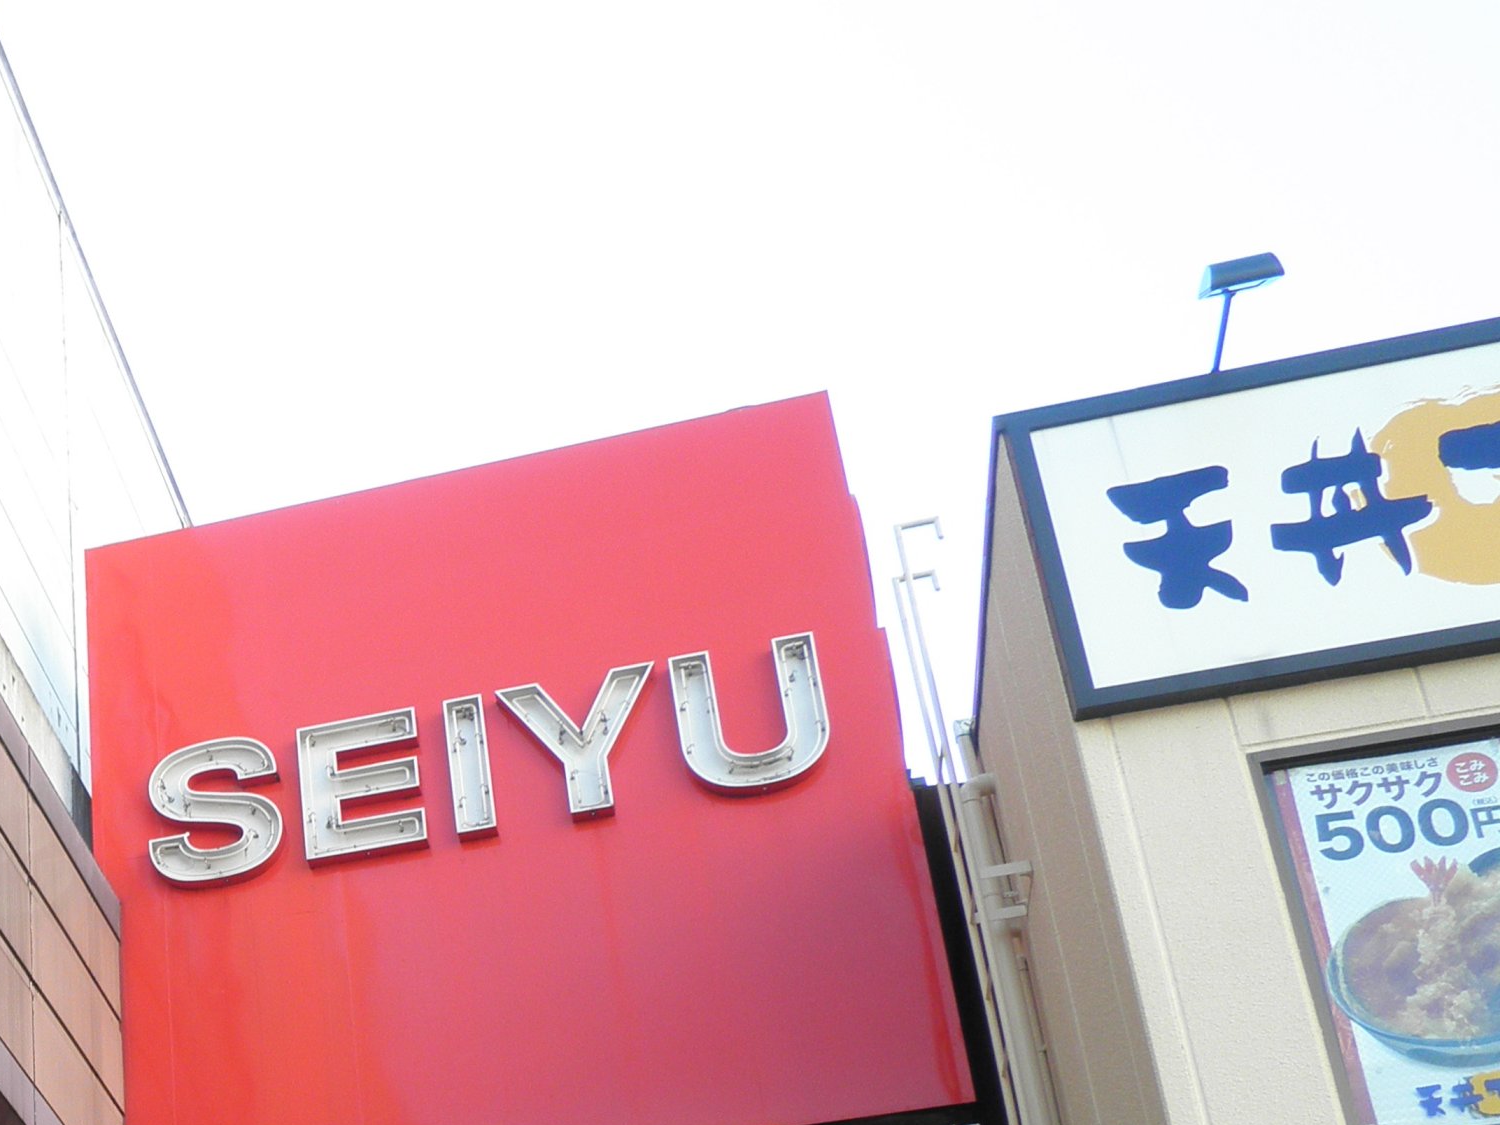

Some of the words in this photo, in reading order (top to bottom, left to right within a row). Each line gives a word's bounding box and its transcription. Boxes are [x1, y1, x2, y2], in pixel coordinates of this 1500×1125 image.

[148, 631, 831, 890] SEIYU
[1305, 757, 1439, 783] この価格この美味しさ
[1309, 770, 1443, 810] サクサク
